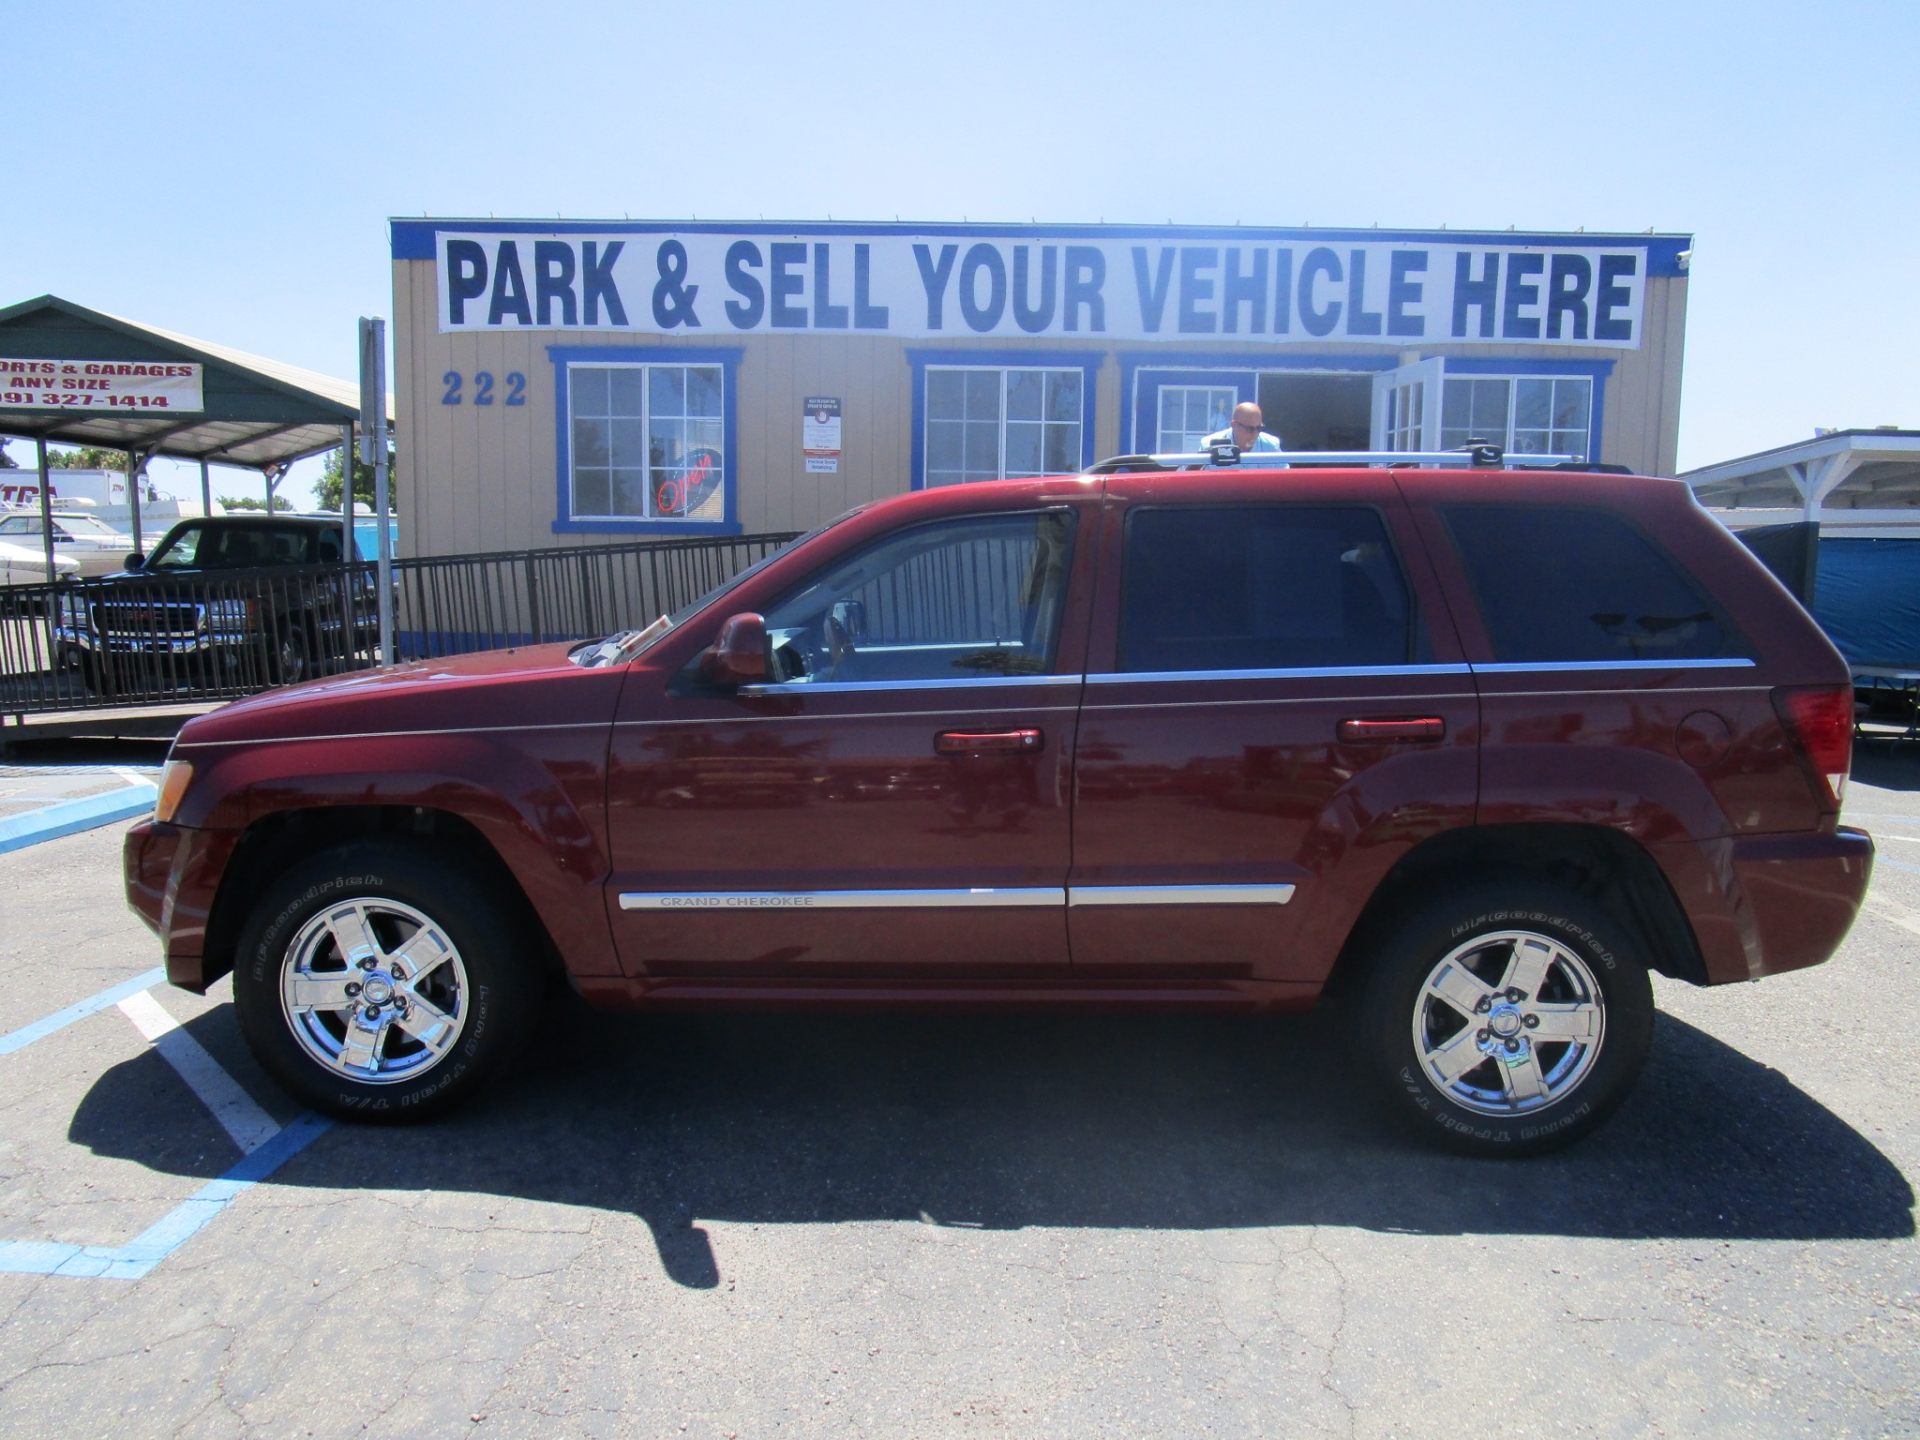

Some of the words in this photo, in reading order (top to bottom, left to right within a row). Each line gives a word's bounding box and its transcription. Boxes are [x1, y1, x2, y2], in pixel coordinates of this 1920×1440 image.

[446, 240, 630, 326] PARK
[652, 239, 702, 329] &
[724, 240, 889, 330] SELL
[911, 243, 1107, 333] YOUR
[1131, 246, 1429, 337] VEHICLE
[1451, 251, 1637, 340] HERE
[61, 364, 78, 374] &
[84, 363, 193, 377] GARAGES
[10, 376, 56, 389] ANY
[62, 378, 111, 391] SIZE
[441, 370, 527, 406] 222
[0, 391, 34, 404] 9)
[42, 393, 169, 408] 327-1414
[658, 454, 713, 512] Open
[660, 896, 721, 906] GRAND
[726, 896, 814, 906] CHEROKEE
